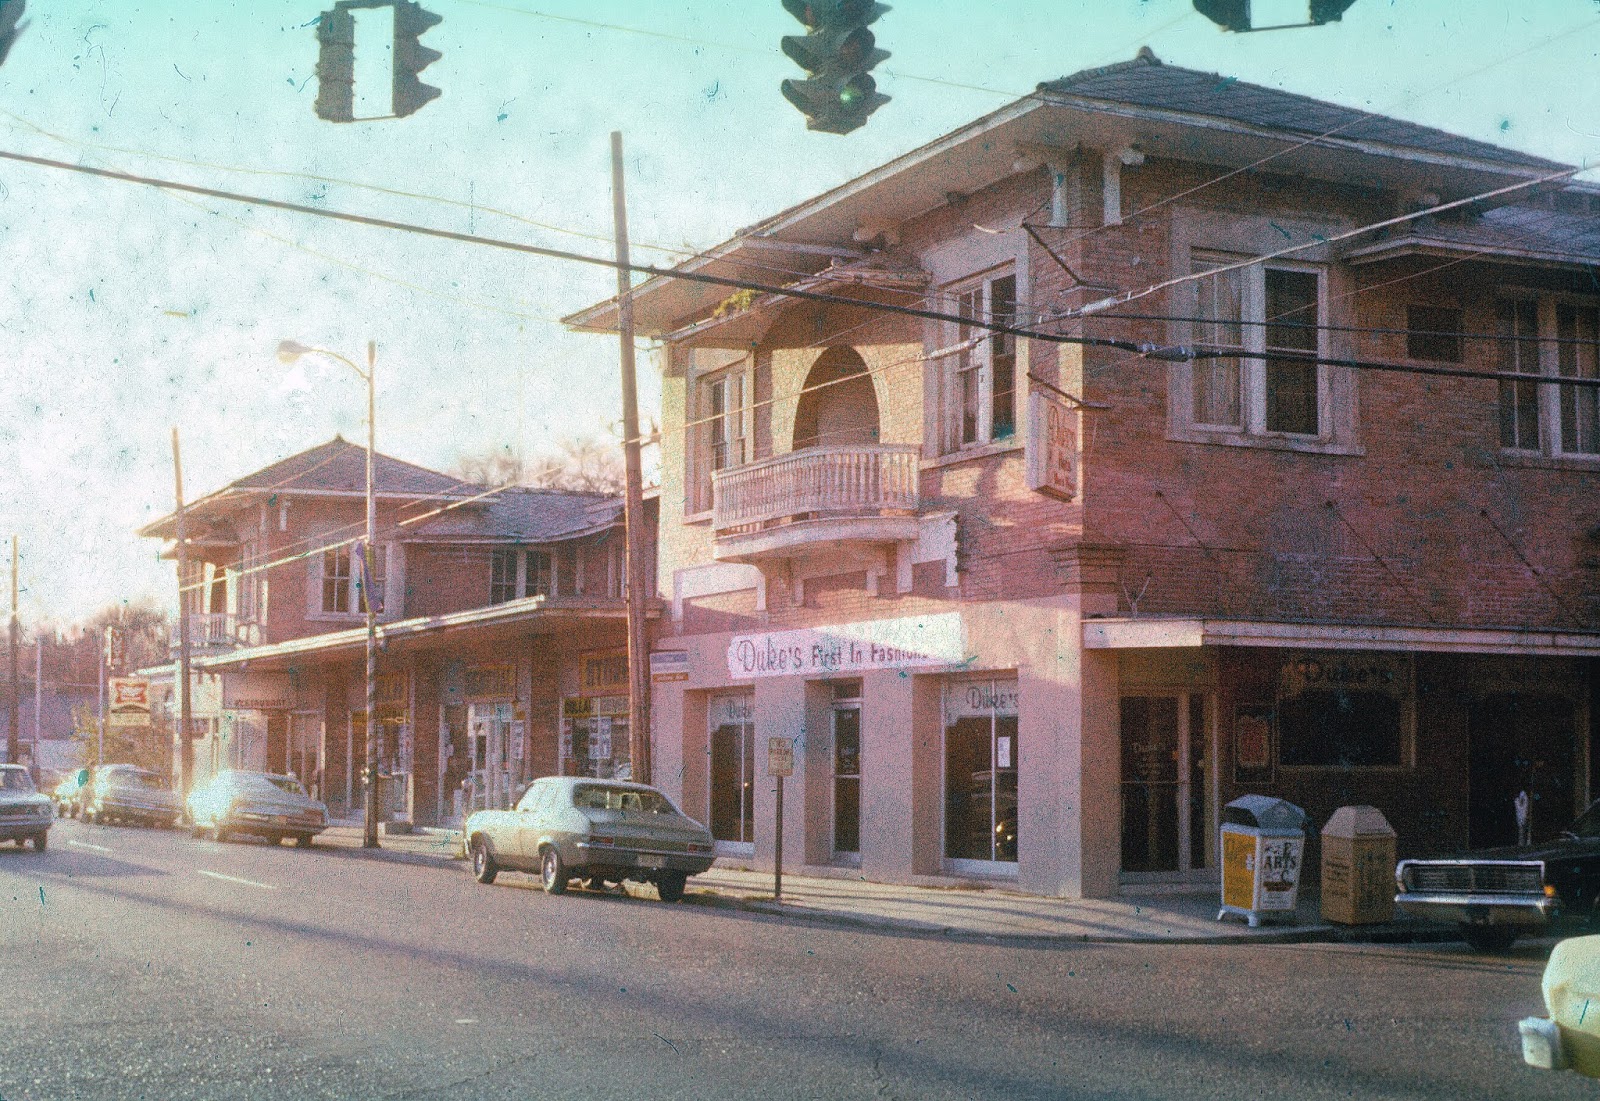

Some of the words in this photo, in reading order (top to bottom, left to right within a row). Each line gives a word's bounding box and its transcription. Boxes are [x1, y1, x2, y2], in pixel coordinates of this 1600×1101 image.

[737, 637, 802, 672] Duke's
[811, 644, 842, 668] First
[850, 642, 863, 664] In
[1297, 657, 1392, 684] Duke's
